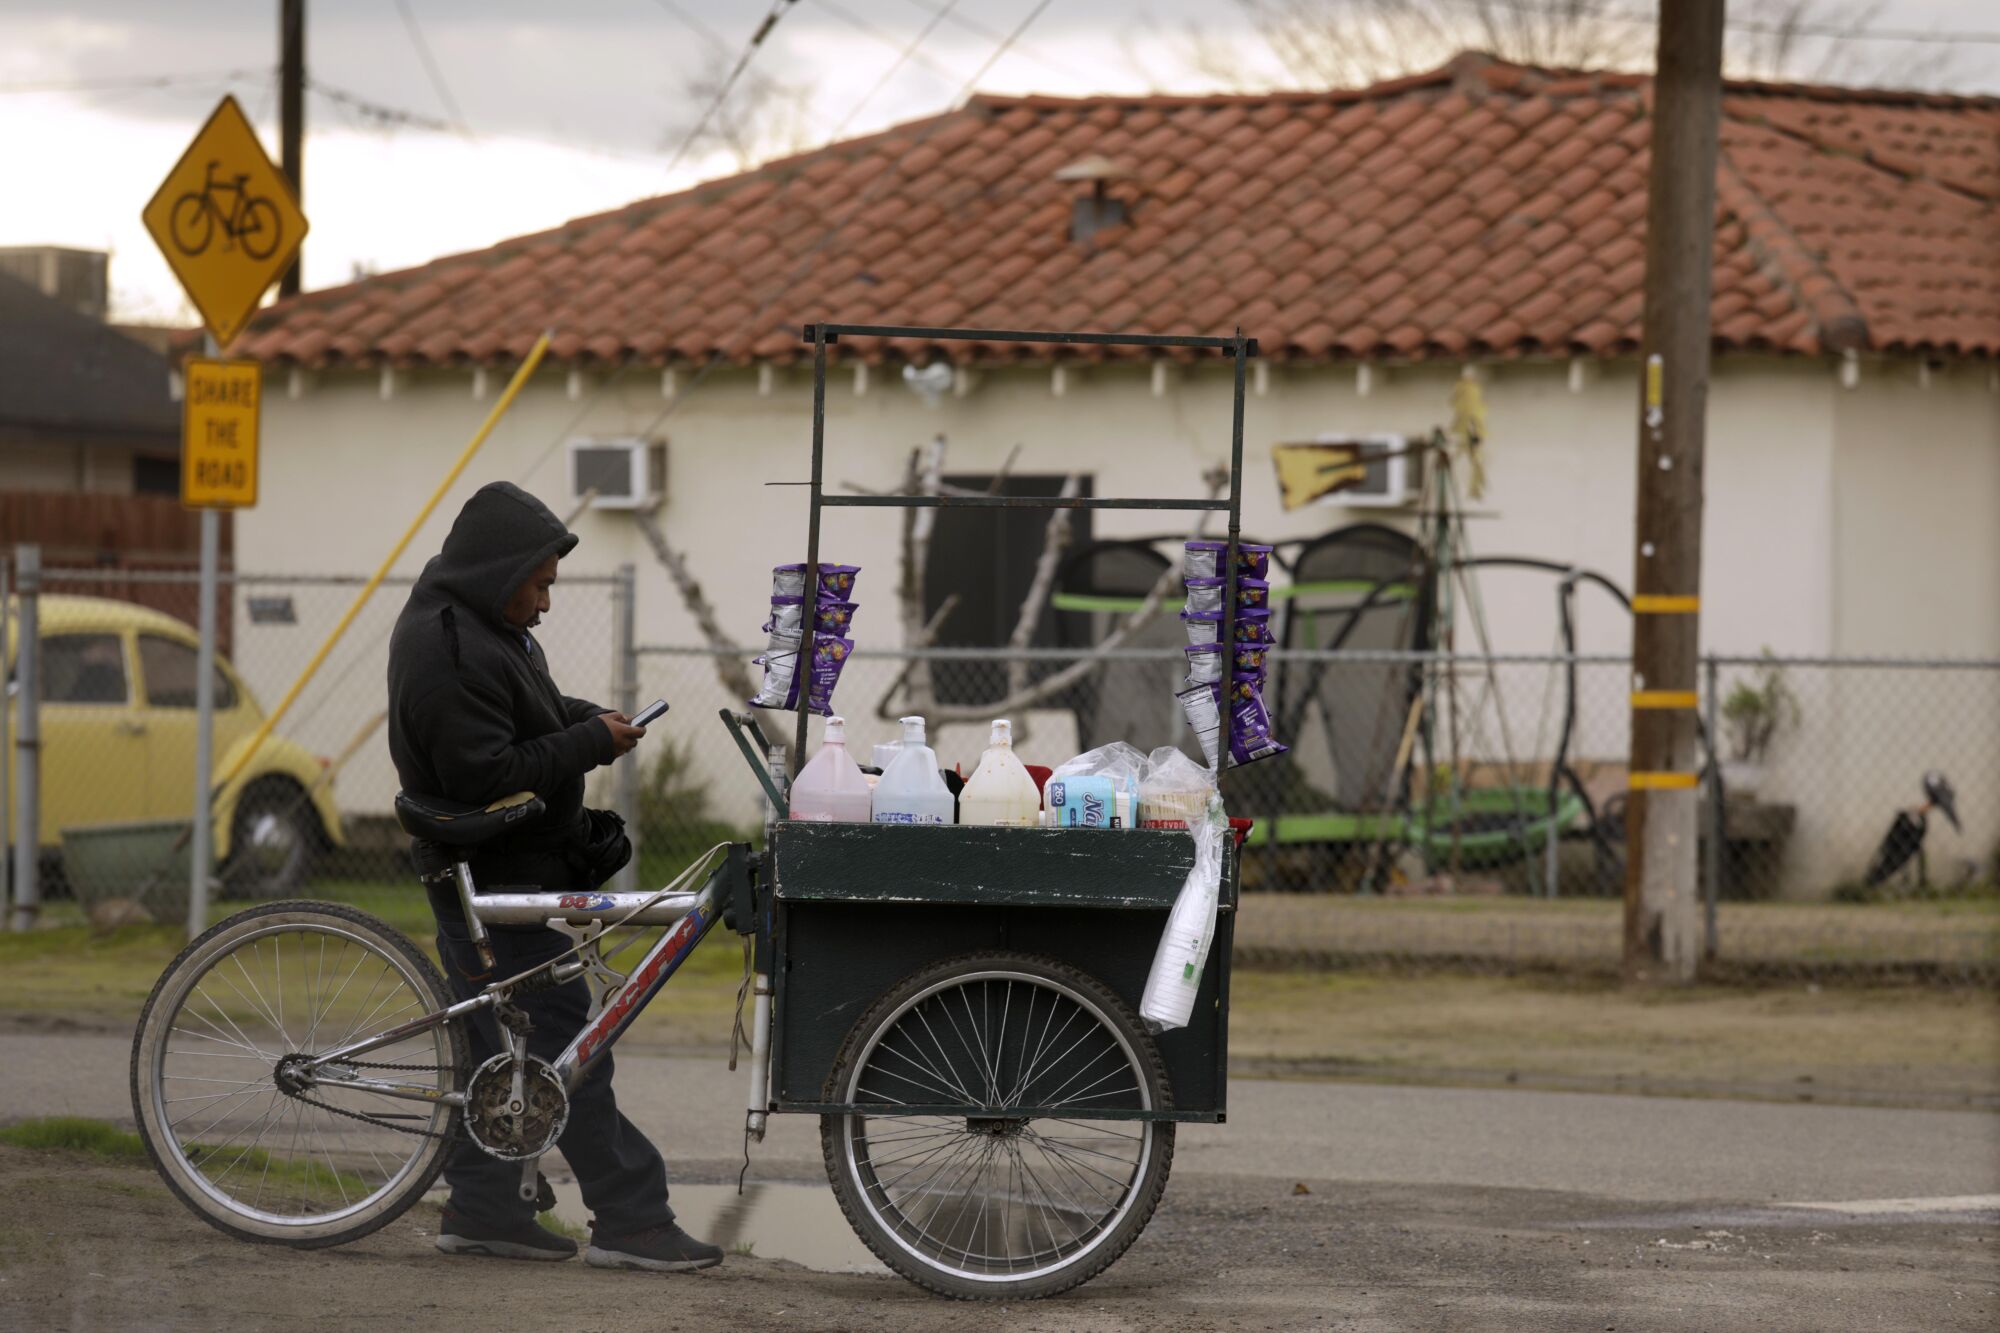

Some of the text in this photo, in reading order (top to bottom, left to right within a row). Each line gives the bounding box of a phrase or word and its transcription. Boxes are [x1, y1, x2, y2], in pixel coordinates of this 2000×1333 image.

[194, 377, 254, 408] SHARE
[205, 416, 239, 449] THE
[196, 457, 246, 490] ROAD
[1054, 784, 1064, 805] 260
